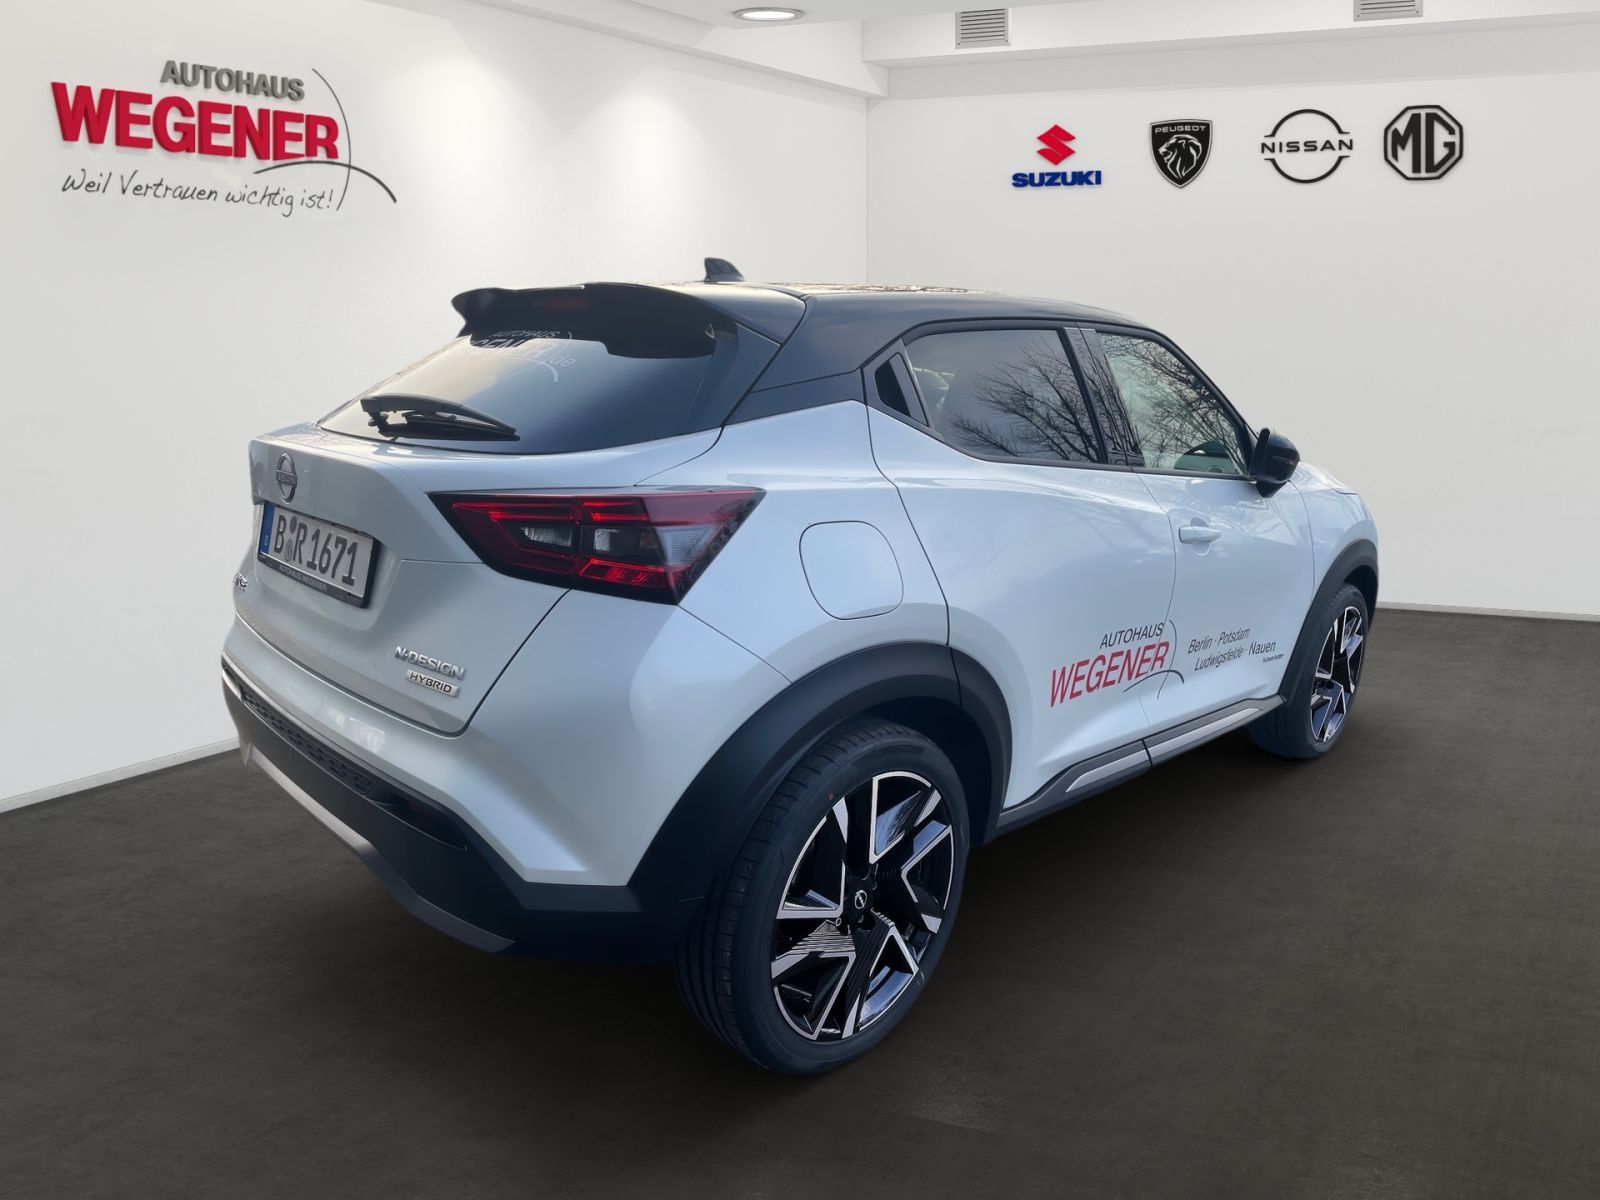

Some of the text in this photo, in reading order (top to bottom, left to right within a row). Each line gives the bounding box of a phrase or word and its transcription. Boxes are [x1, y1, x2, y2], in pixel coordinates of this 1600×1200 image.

[159, 60, 304, 101] AUTOHAUS
[51, 81, 339, 161] WEGENER
[1155, 125, 1207, 134] PEUGEOT
[1261, 138, 1354, 154] NISSAN
[1391, 112, 1456, 174] MG
[62, 168, 334, 218] Weil Vertrauen wichtig ist!
[1012, 170, 1102, 188] SUZUKI
[273, 514, 287, 554] B
[1099, 622, 1164, 650] AUTOHAUS
[1187, 628, 1251, 654] Berlin Potsdam
[1194, 646, 1244, 671] Ludwigsfelde
[1248, 641, 1276, 656] Nauen
[410, 671, 452, 693] HYBRID
[1050, 641, 1169, 708] WEGENER
